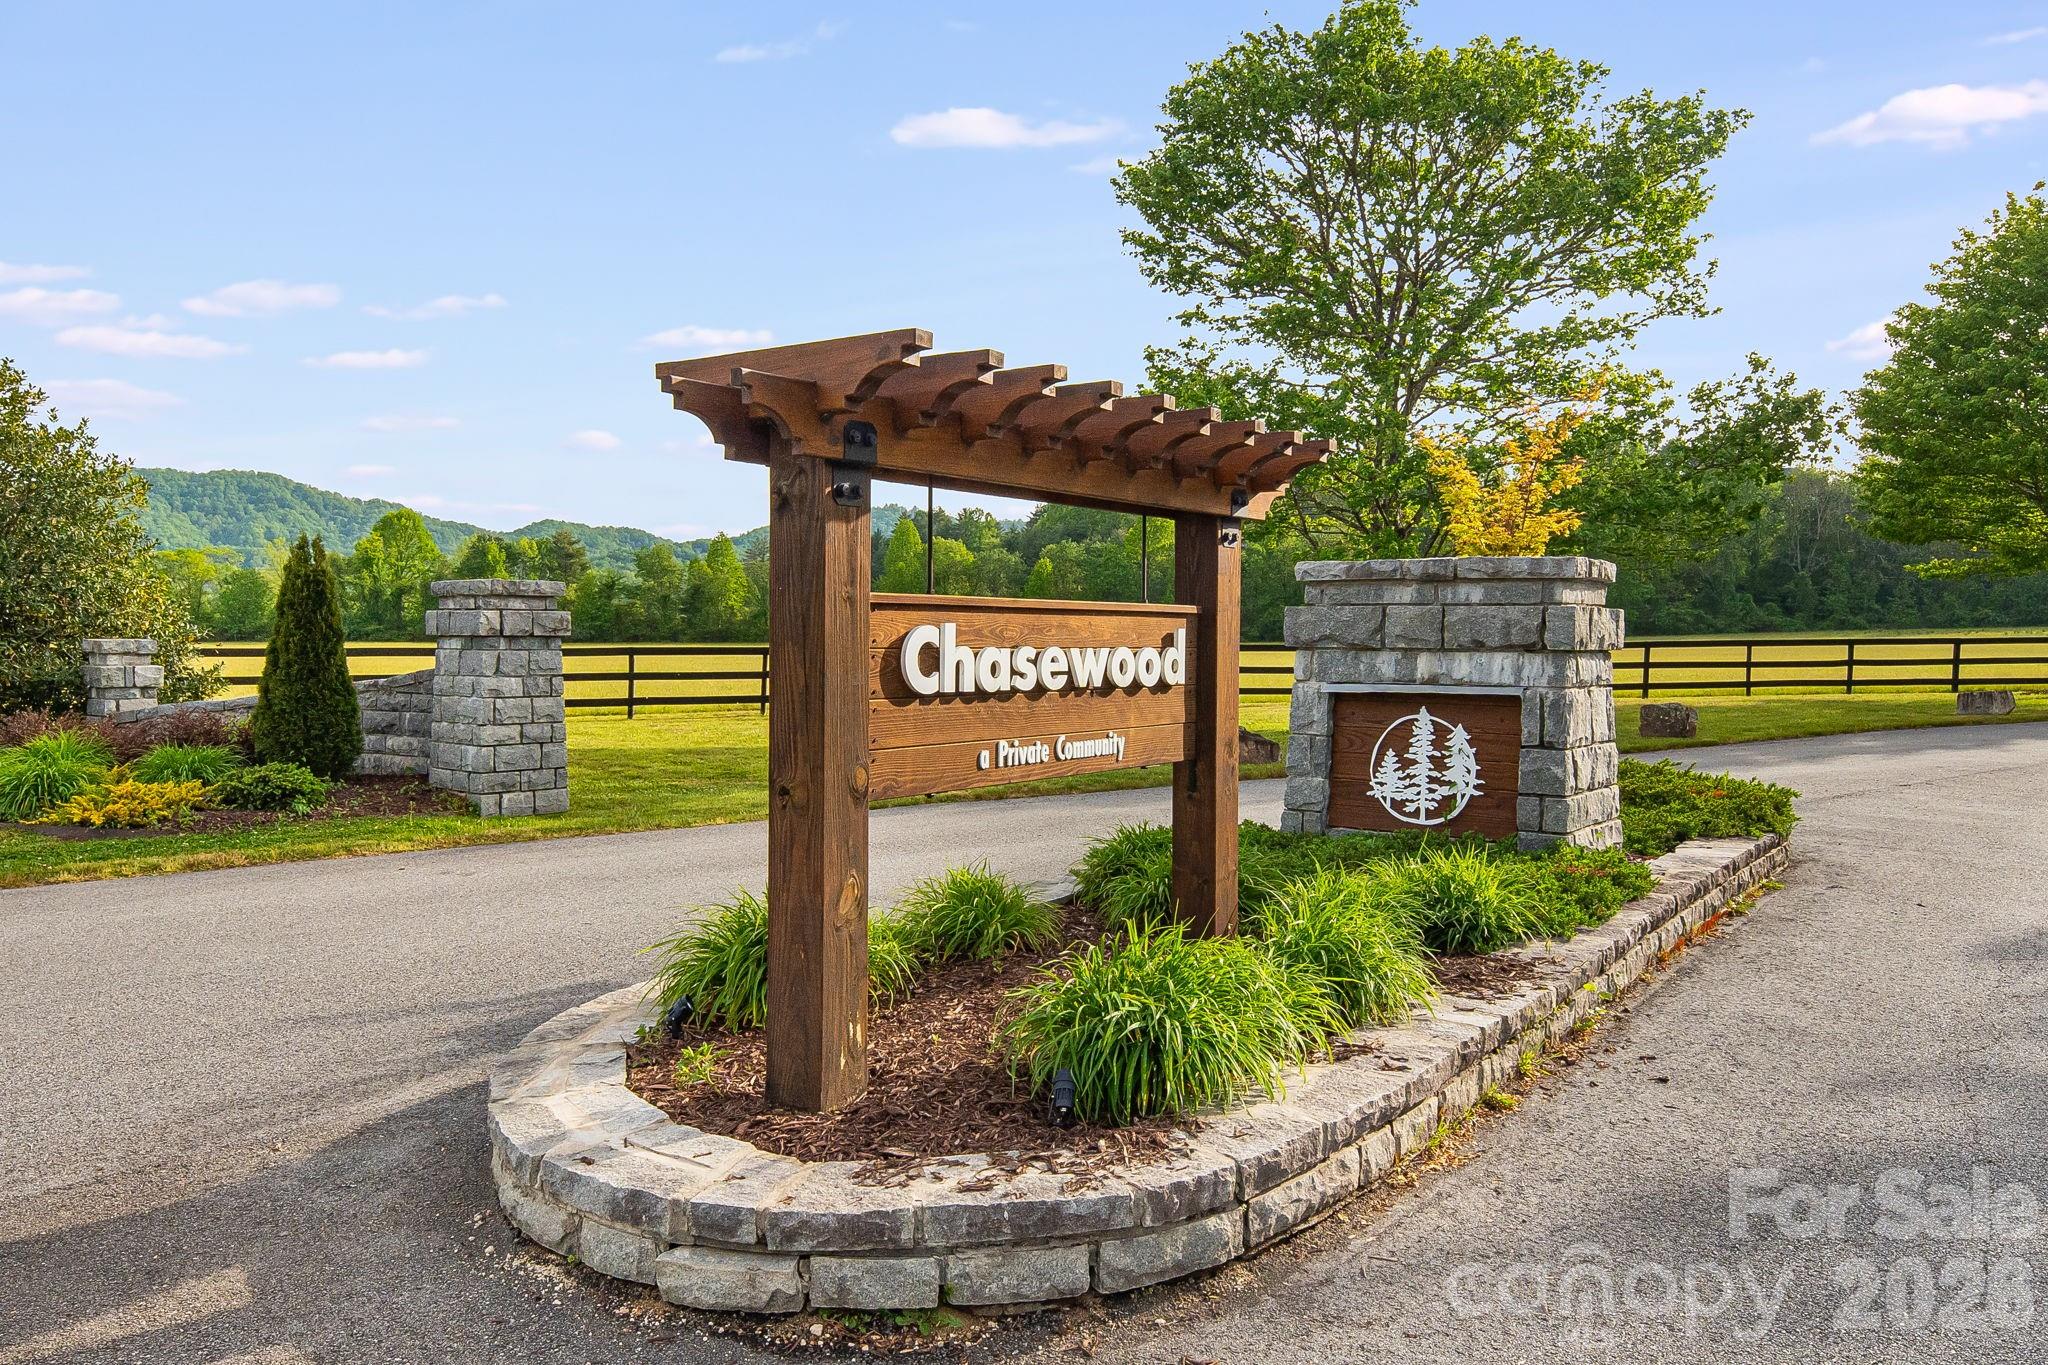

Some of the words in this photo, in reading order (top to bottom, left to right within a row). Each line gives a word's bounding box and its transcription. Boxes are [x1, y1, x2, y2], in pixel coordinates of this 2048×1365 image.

[901, 622, 1186, 695] Chasewood
[979, 749, 990, 770] a
[997, 740, 1049, 768] Private
[1055, 731, 1126, 761] Community
